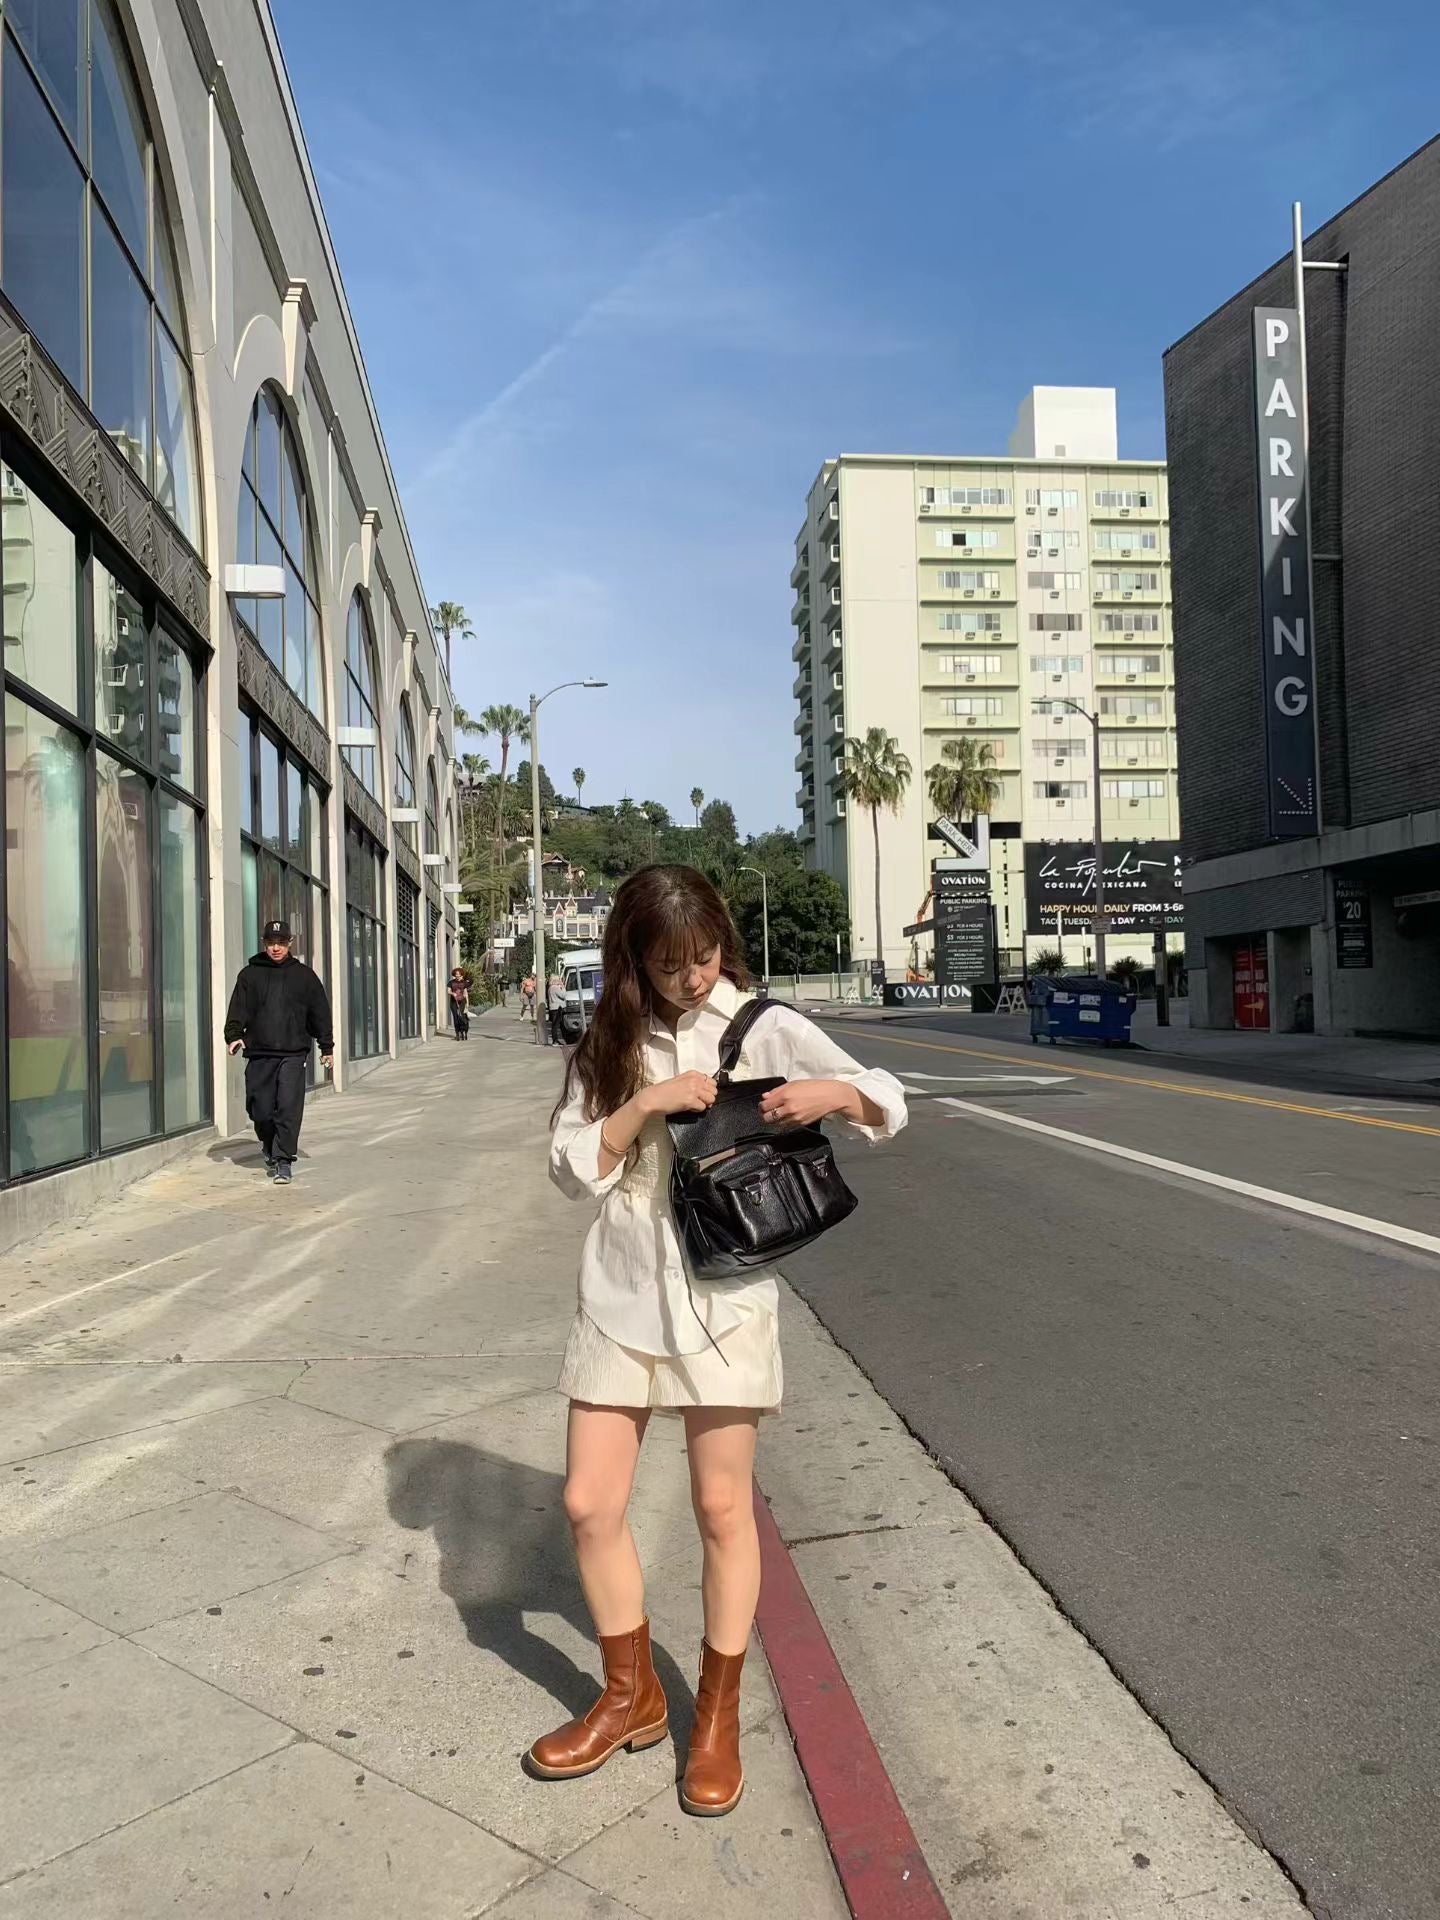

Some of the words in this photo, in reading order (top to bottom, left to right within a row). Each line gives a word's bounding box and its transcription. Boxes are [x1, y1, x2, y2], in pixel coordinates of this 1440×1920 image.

[1265, 318, 1308, 717] PARKING
[939, 819, 958, 840] PARK
[957, 836, 977, 857] HERE
[941, 874, 986, 885] OVATION
[1040, 904, 1071, 913] HAPPY
[1104, 904, 1131, 913] DAILY
[1132, 903, 1161, 912] FROM
[1117, 917, 1135, 925] DAY
[894, 984, 972, 999] OVATION
